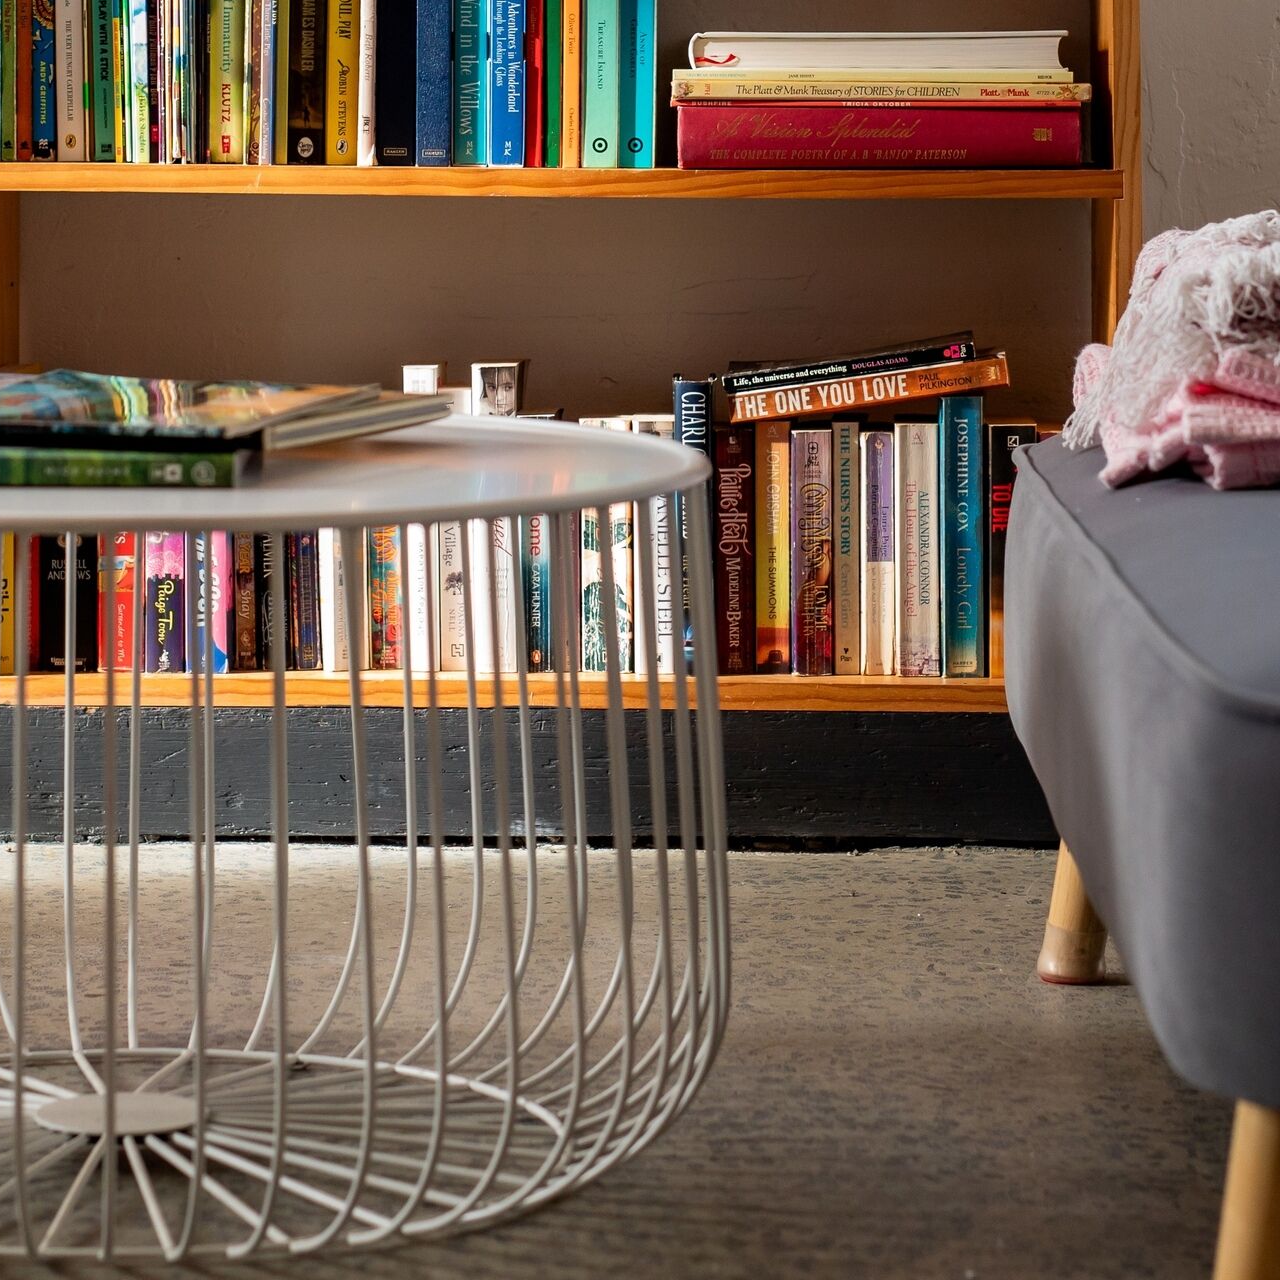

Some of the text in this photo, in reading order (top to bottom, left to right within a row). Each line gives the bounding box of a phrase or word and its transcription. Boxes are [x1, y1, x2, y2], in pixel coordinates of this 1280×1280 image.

[98, 0, 108, 21] PLAY
[508, 1, 520, 50] Adventures
[99, 24, 108, 46] WITH
[220, 6, 234, 74] Immaturity
[336, 20, 352, 40] PLAY
[460, 34, 478, 48] in
[66, 52, 74, 78] HUNGRY
[100, 48, 108, 56] A
[460, 54, 479, 76] the
[508, 51, 520, 60] in
[640, 32, 648, 66] ANNE OF
[100, 57, 109, 81] STICK
[66, 78, 74, 122] CATERPILLAR
[222, 84, 231, 123] KLUTZ
[507, 62, 520, 112] Wonderland
[736, 84, 960, 98] The Platt & Munk Treasury of STORIES for CHILDREN
[459, 80, 480, 135] Willows
[712, 112, 921, 148] A Vision Splendid
[710, 150, 730, 160] THE
[733, 150, 788, 160] COMPLETE
[791, 150, 830, 160] POETRY
[834, 150, 847, 160] OF
[872, 149, 913, 160] "BANJO"
[914, 148, 968, 160] PATERSON
[734, 364, 848, 386] Life, the universe and everything
[852, 356, 909, 370] DOUGLAS ADAMS
[918, 372, 940, 383] PAUL
[734, 374, 908, 420] THE ONE YOU LOVE
[919, 376, 972, 392] PILKINGTON
[840, 426, 851, 556] THE NURSE'S STORY
[954, 416, 968, 533] JOSEPHINE COX
[718, 464, 752, 556] Prairie Heat
[766, 449, 780, 536] JOHN GRISHAM
[992, 482, 1012, 533] TO DIE
[880, 506, 889, 534] Laurie
[240, 543, 250, 574] YEAR
[442, 526, 456, 566] Village
[879, 534, 889, 558] Paige
[904, 480, 918, 617] The Hour of the Angel
[920, 490, 930, 606] ALEXANDRA CONNOR
[532, 563, 541, 628] CARA HUNTER
[768, 546, 776, 620] THE SUMMONS
[954, 547, 972, 629] Lonely Girl
[154, 580, 174, 645] Paige Toon
[238, 590, 250, 619] Shay
[448, 608, 456, 632] NELL
[726, 558, 740, 648] MADELINE BAKER
